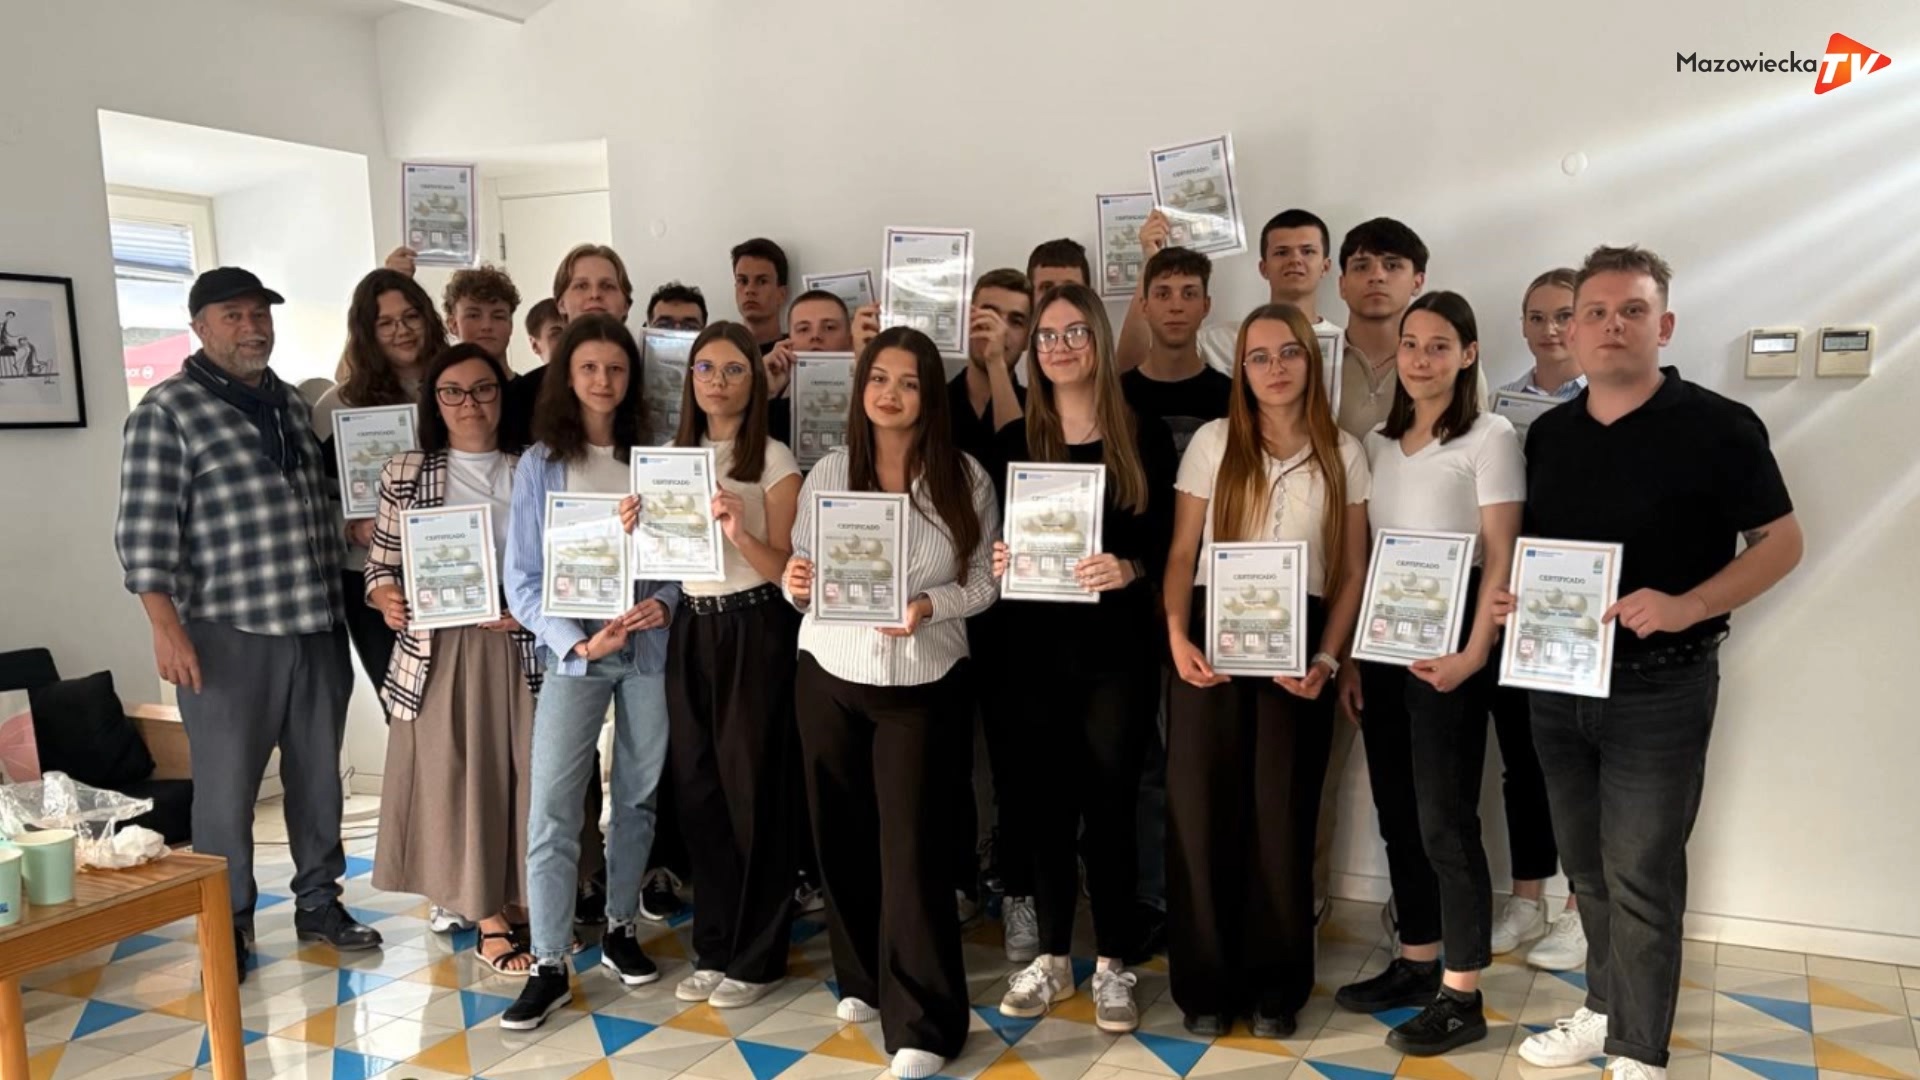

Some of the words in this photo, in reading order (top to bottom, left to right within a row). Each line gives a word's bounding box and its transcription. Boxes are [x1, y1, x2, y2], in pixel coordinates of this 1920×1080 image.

[837, 523, 880, 531] CERTIFICADO
[425, 533, 465, 541] CERTIFICADO
[1396, 560, 1440, 570] CERTIFICADO
[1539, 574, 1586, 584] CERTIFICADO
